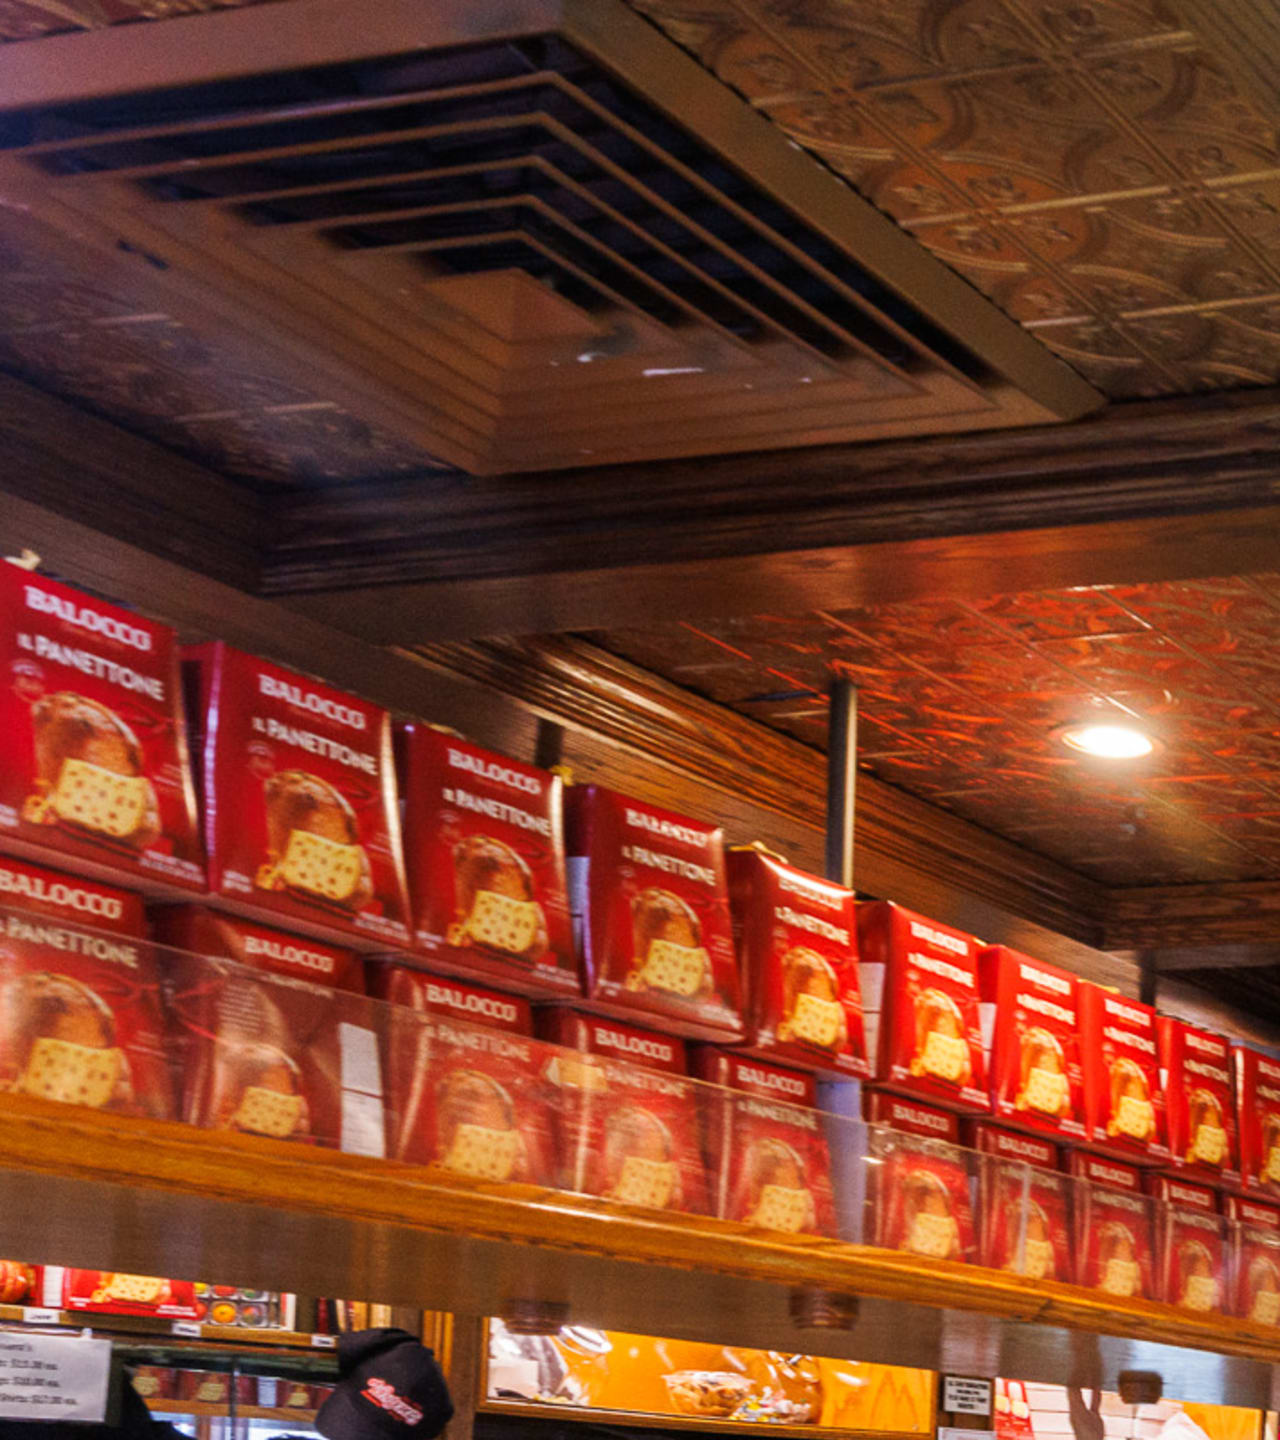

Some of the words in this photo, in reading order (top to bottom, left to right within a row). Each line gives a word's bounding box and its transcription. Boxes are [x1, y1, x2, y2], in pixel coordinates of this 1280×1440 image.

[25, 585, 152, 651] BALOCCO
[36, 636, 164, 700] PANETTONE
[259, 674, 366, 730] BALOCCO
[268, 719, 378, 776] PANETTONE
[447, 748, 541, 794] BALOCCO
[455, 791, 552, 836] PANETTONE
[626, 808, 708, 848] BALOCCO
[633, 845, 716, 886] PANETTONE
[0, 870, 122, 920] BALOCCO
[8, 917, 139, 969] PANETTONE
[244, 935, 334, 973] BALOCCO
[426, 984, 517, 1022] BALOCCO
[439, 1025, 531, 1063] PANETTONE
[595, 1027, 673, 1062] BALOCCO
[737, 1066, 804, 1097] BALOCCO
[893, 1104, 950, 1133] BALOCCO
